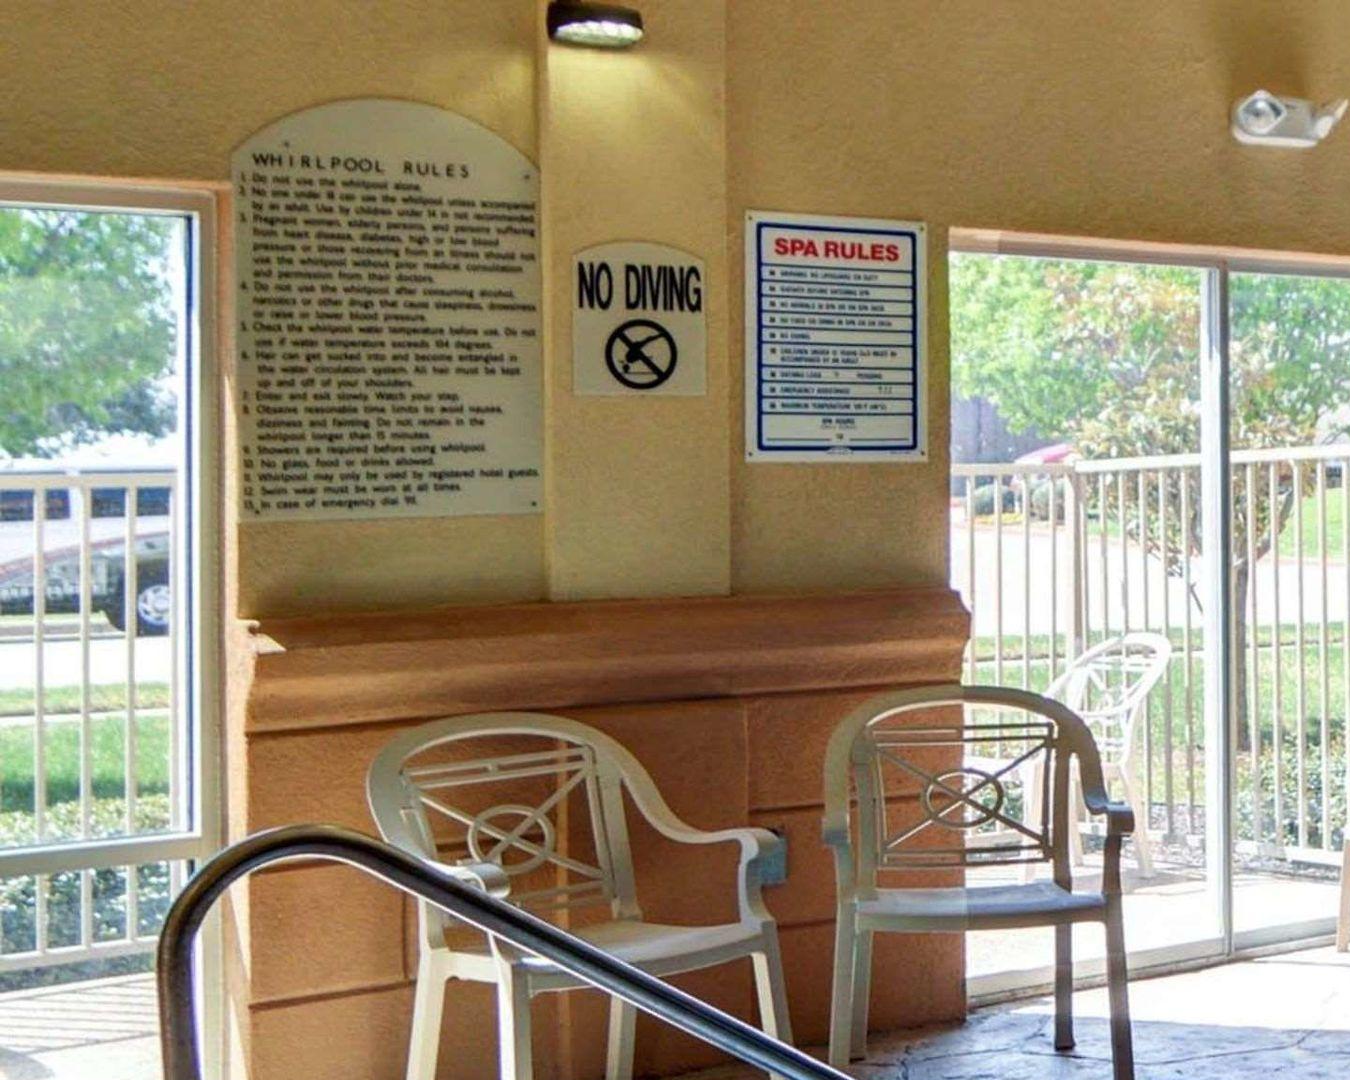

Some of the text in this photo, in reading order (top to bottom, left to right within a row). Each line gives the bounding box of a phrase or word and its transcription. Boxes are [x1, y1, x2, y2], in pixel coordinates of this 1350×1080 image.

[252, 152, 469, 179] WHIRLPOOL RULES
[774, 237, 900, 262] SPA RULES
[578, 261, 702, 312] NO DIVING
